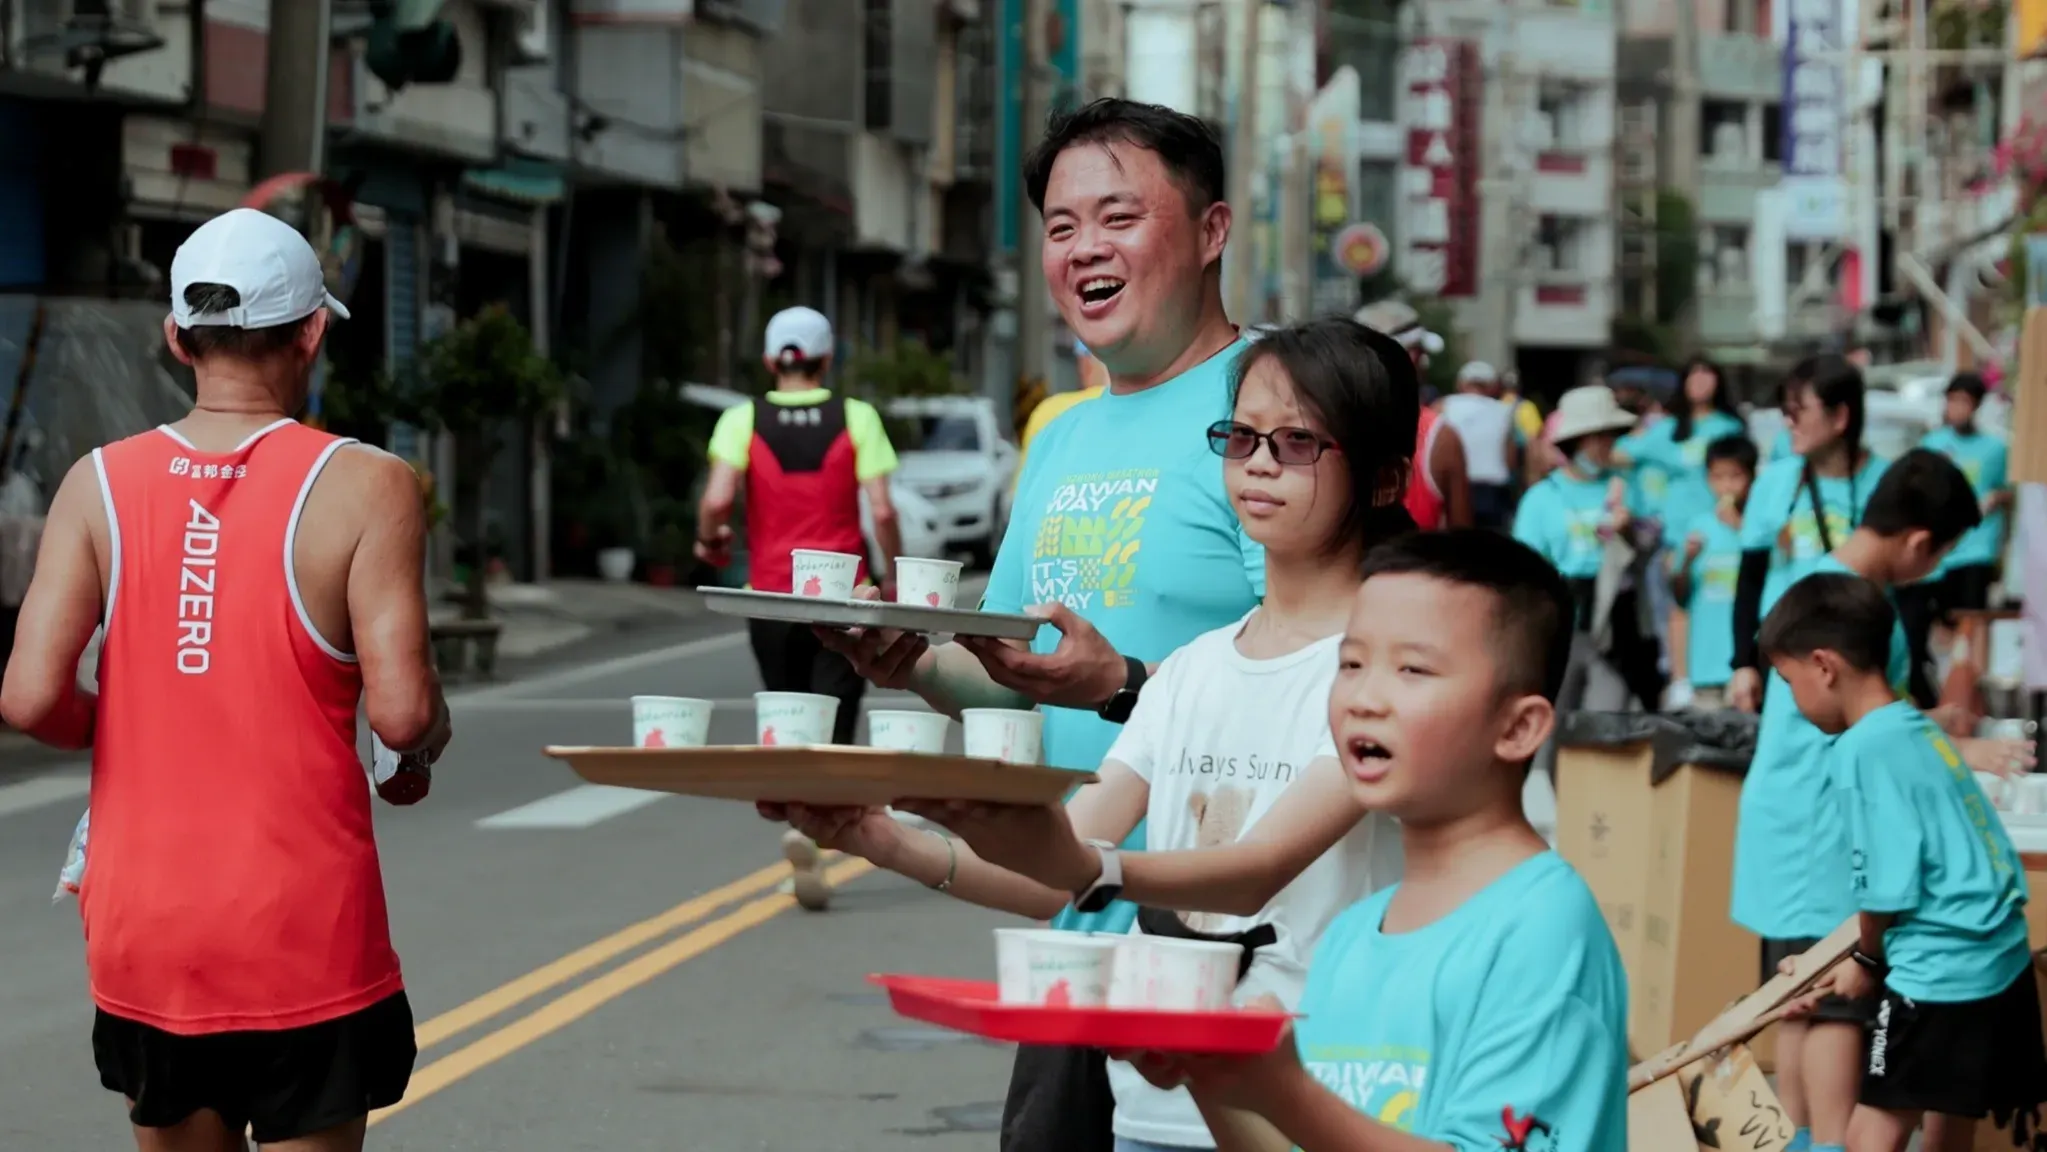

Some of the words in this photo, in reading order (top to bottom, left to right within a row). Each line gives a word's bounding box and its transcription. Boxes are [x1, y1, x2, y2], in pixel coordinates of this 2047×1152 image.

[177, 498, 221, 674] ADIZERO
[1032, 558, 1078, 580] IT'S
[1033, 577, 1074, 597] MY
[1868, 1028, 1887, 1076] YONEX
